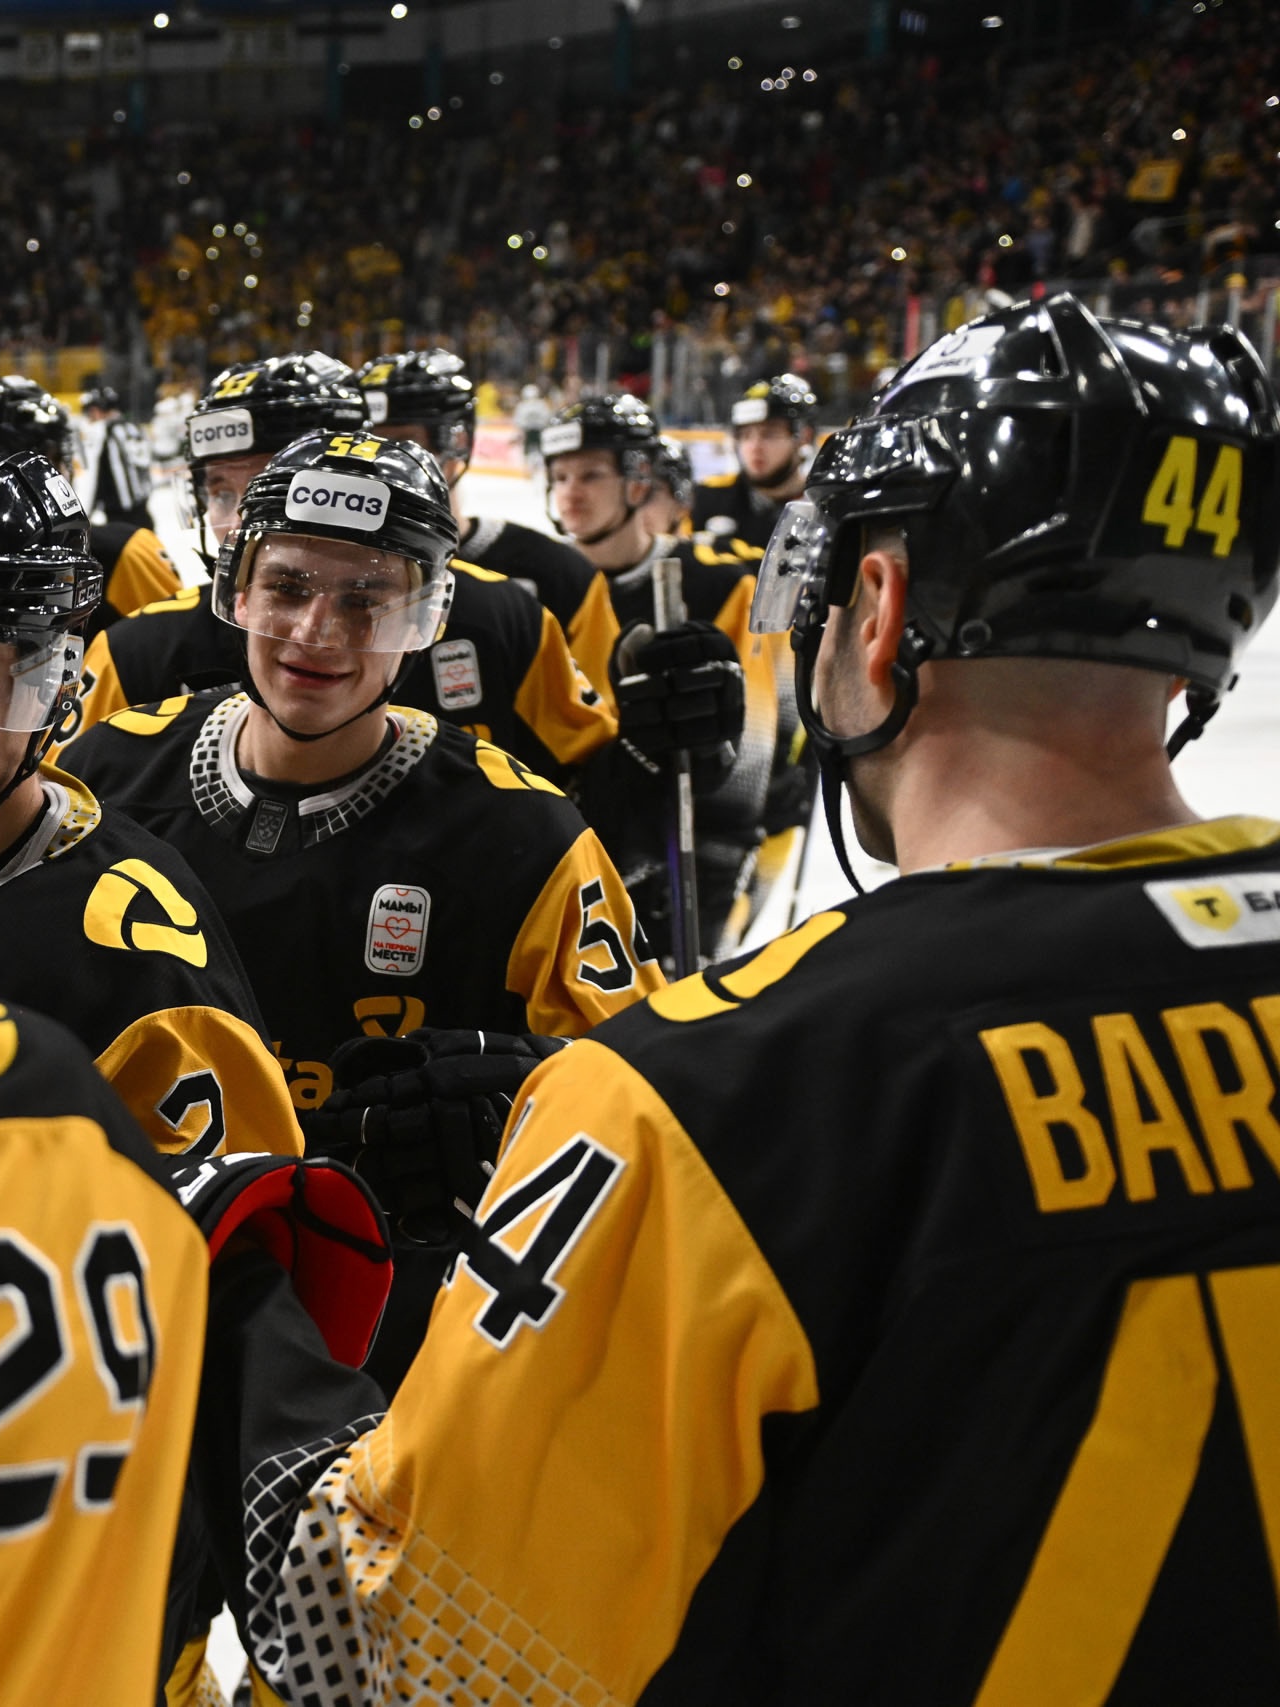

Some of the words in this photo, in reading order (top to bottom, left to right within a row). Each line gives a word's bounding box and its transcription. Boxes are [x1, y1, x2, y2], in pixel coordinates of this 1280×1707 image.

[193, 421, 250, 444] согаз
[325, 436, 381, 463] 54
[292, 486, 383, 516] согаз
[1142, 436, 1243, 559] 44
[379, 899, 423, 914] МАМЫ
[1243, 889, 1280, 912] Б
[372, 947, 417, 963] МЕСТЕ
[978, 995, 1280, 1213] BAR
[443, 1097, 627, 1351] 4
